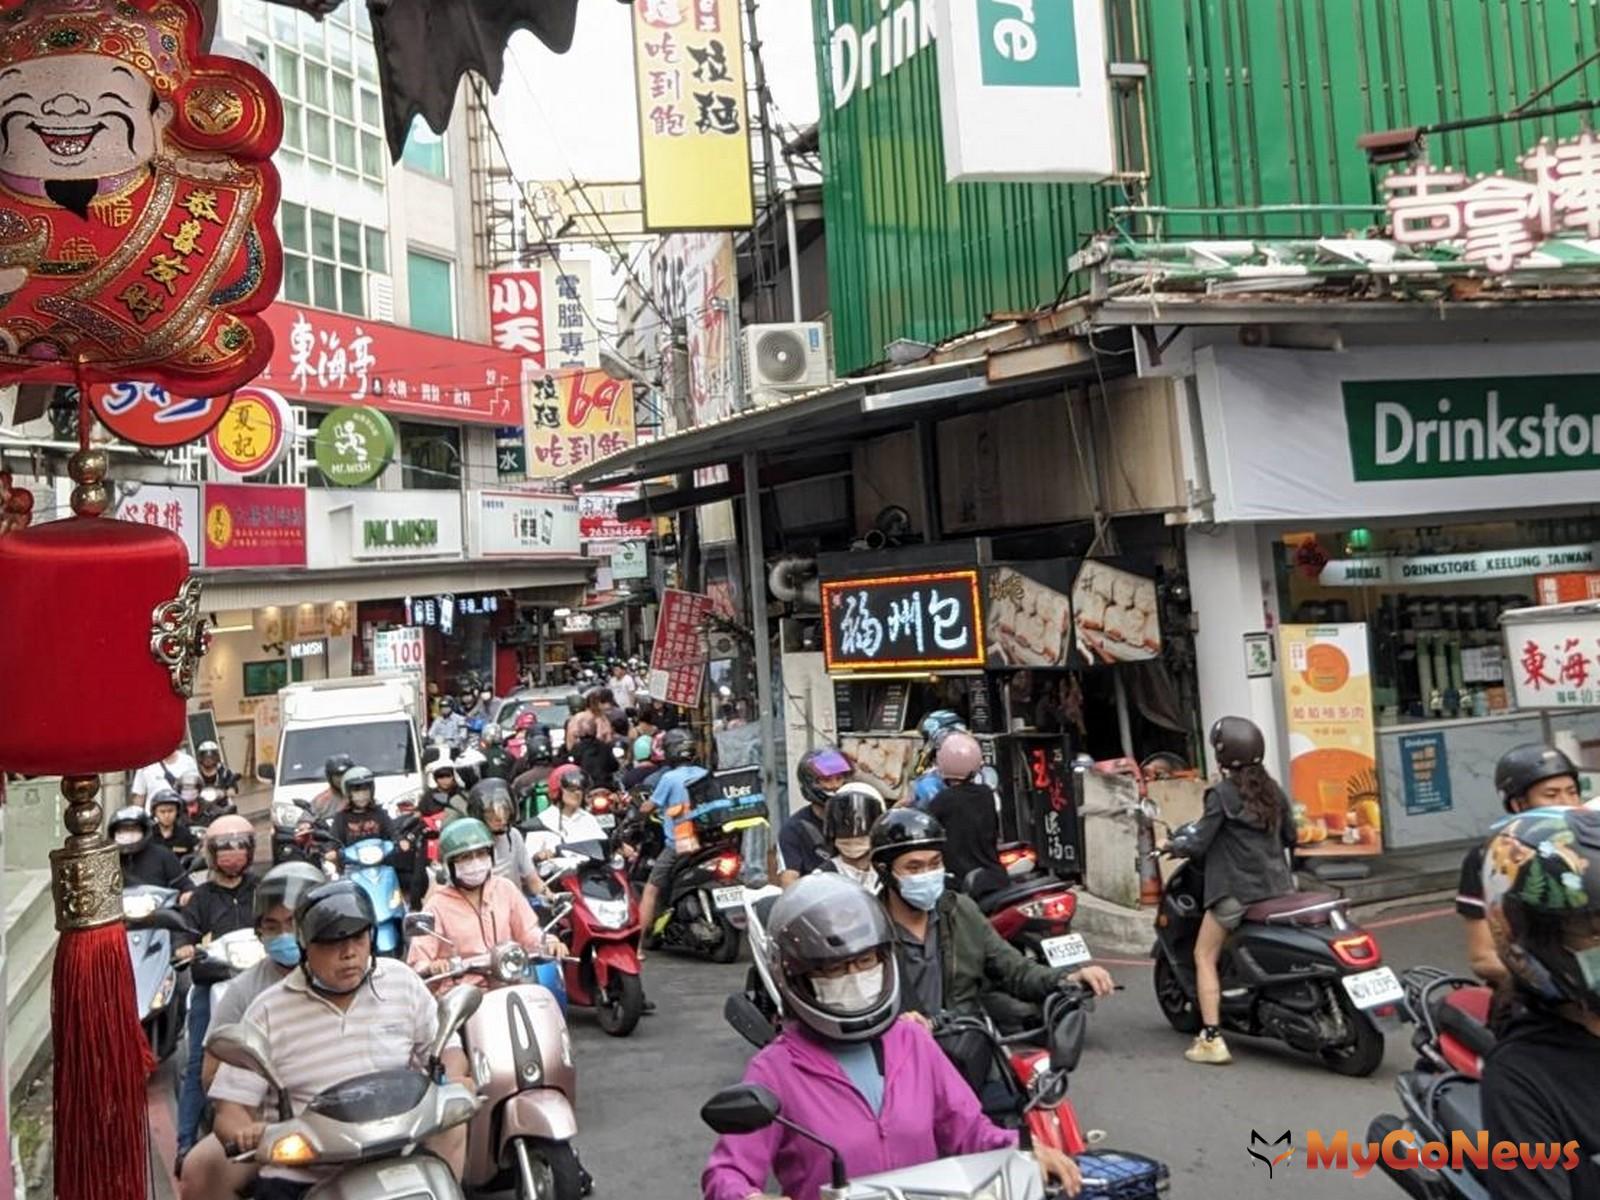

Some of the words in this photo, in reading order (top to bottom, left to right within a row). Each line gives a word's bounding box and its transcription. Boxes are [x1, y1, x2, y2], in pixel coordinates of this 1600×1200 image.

[644, 31, 688, 136] 吃到飽
[686, 40, 740, 135] 拉麵
[1383, 133, 1600, 272] 吉拿棒
[492, 278, 543, 370] 小天
[290, 310, 377, 400] 東海亭
[566, 369, 624, 428] 69
[234, 404, 256, 458] 夏記
[534, 431, 630, 467] 吃到飽
[499, 452, 519, 470] 水
[1402, 560, 1477, 578] DRINKSTORE
[1486, 554, 1542, 571] KEELUNG
[1547, 551, 1593, 566] TAIWAN
[839, 588, 968, 657] 福州包
[391, 642, 423, 665] 100
[1520, 637, 1600, 691] 東海
[722, 785, 752, 799] Uber
